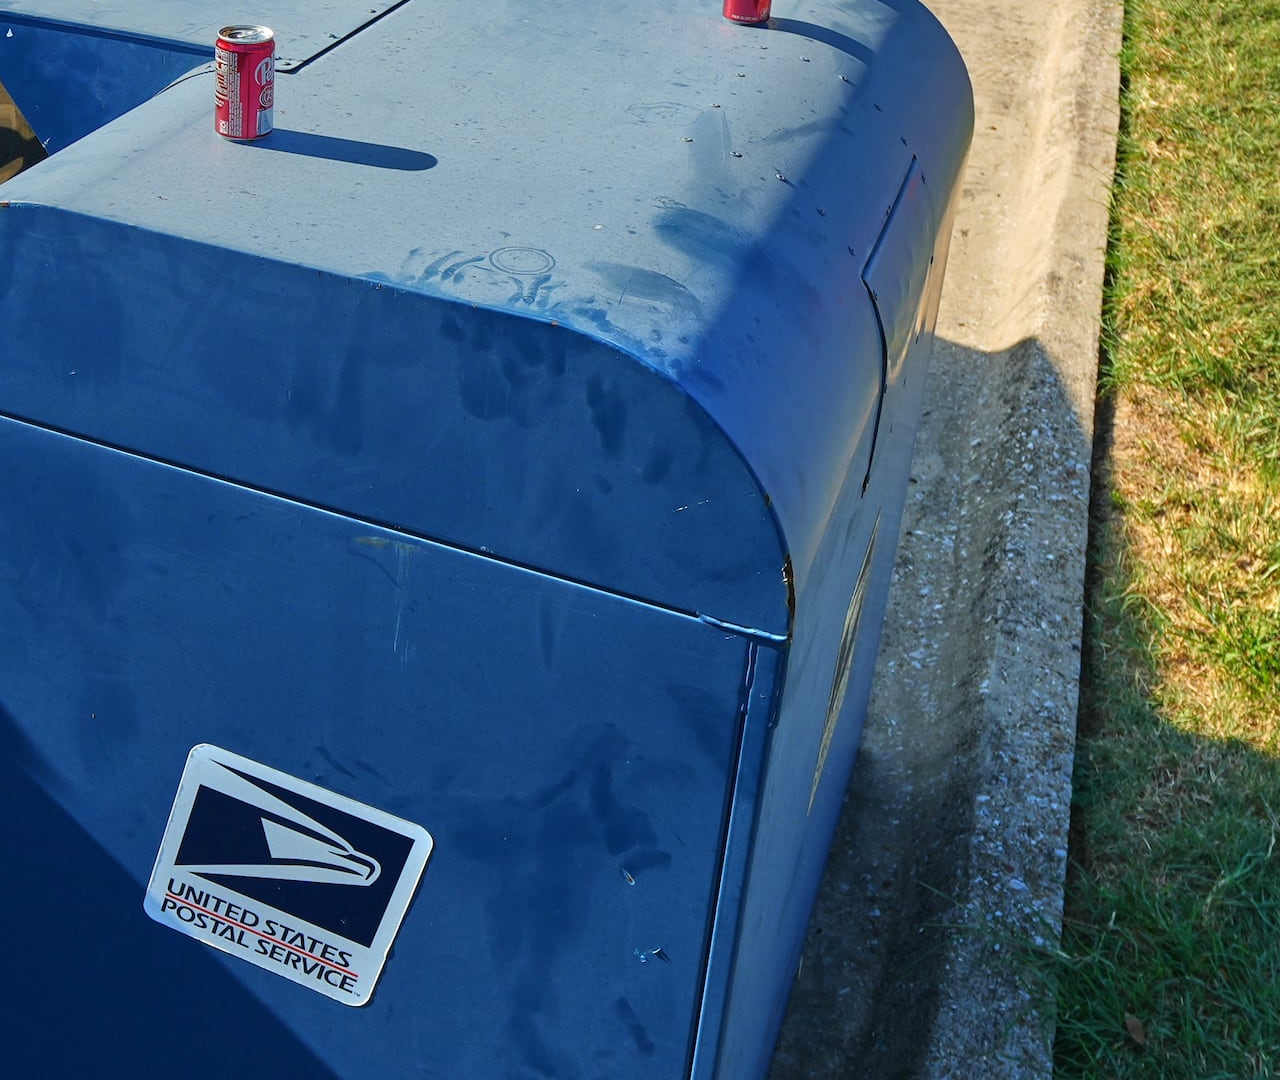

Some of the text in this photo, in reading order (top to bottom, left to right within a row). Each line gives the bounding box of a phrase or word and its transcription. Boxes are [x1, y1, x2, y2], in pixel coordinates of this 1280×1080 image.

[160, 897, 358, 995] POSTAL SERVICE
[167, 878, 353, 968] UNITED STATES
